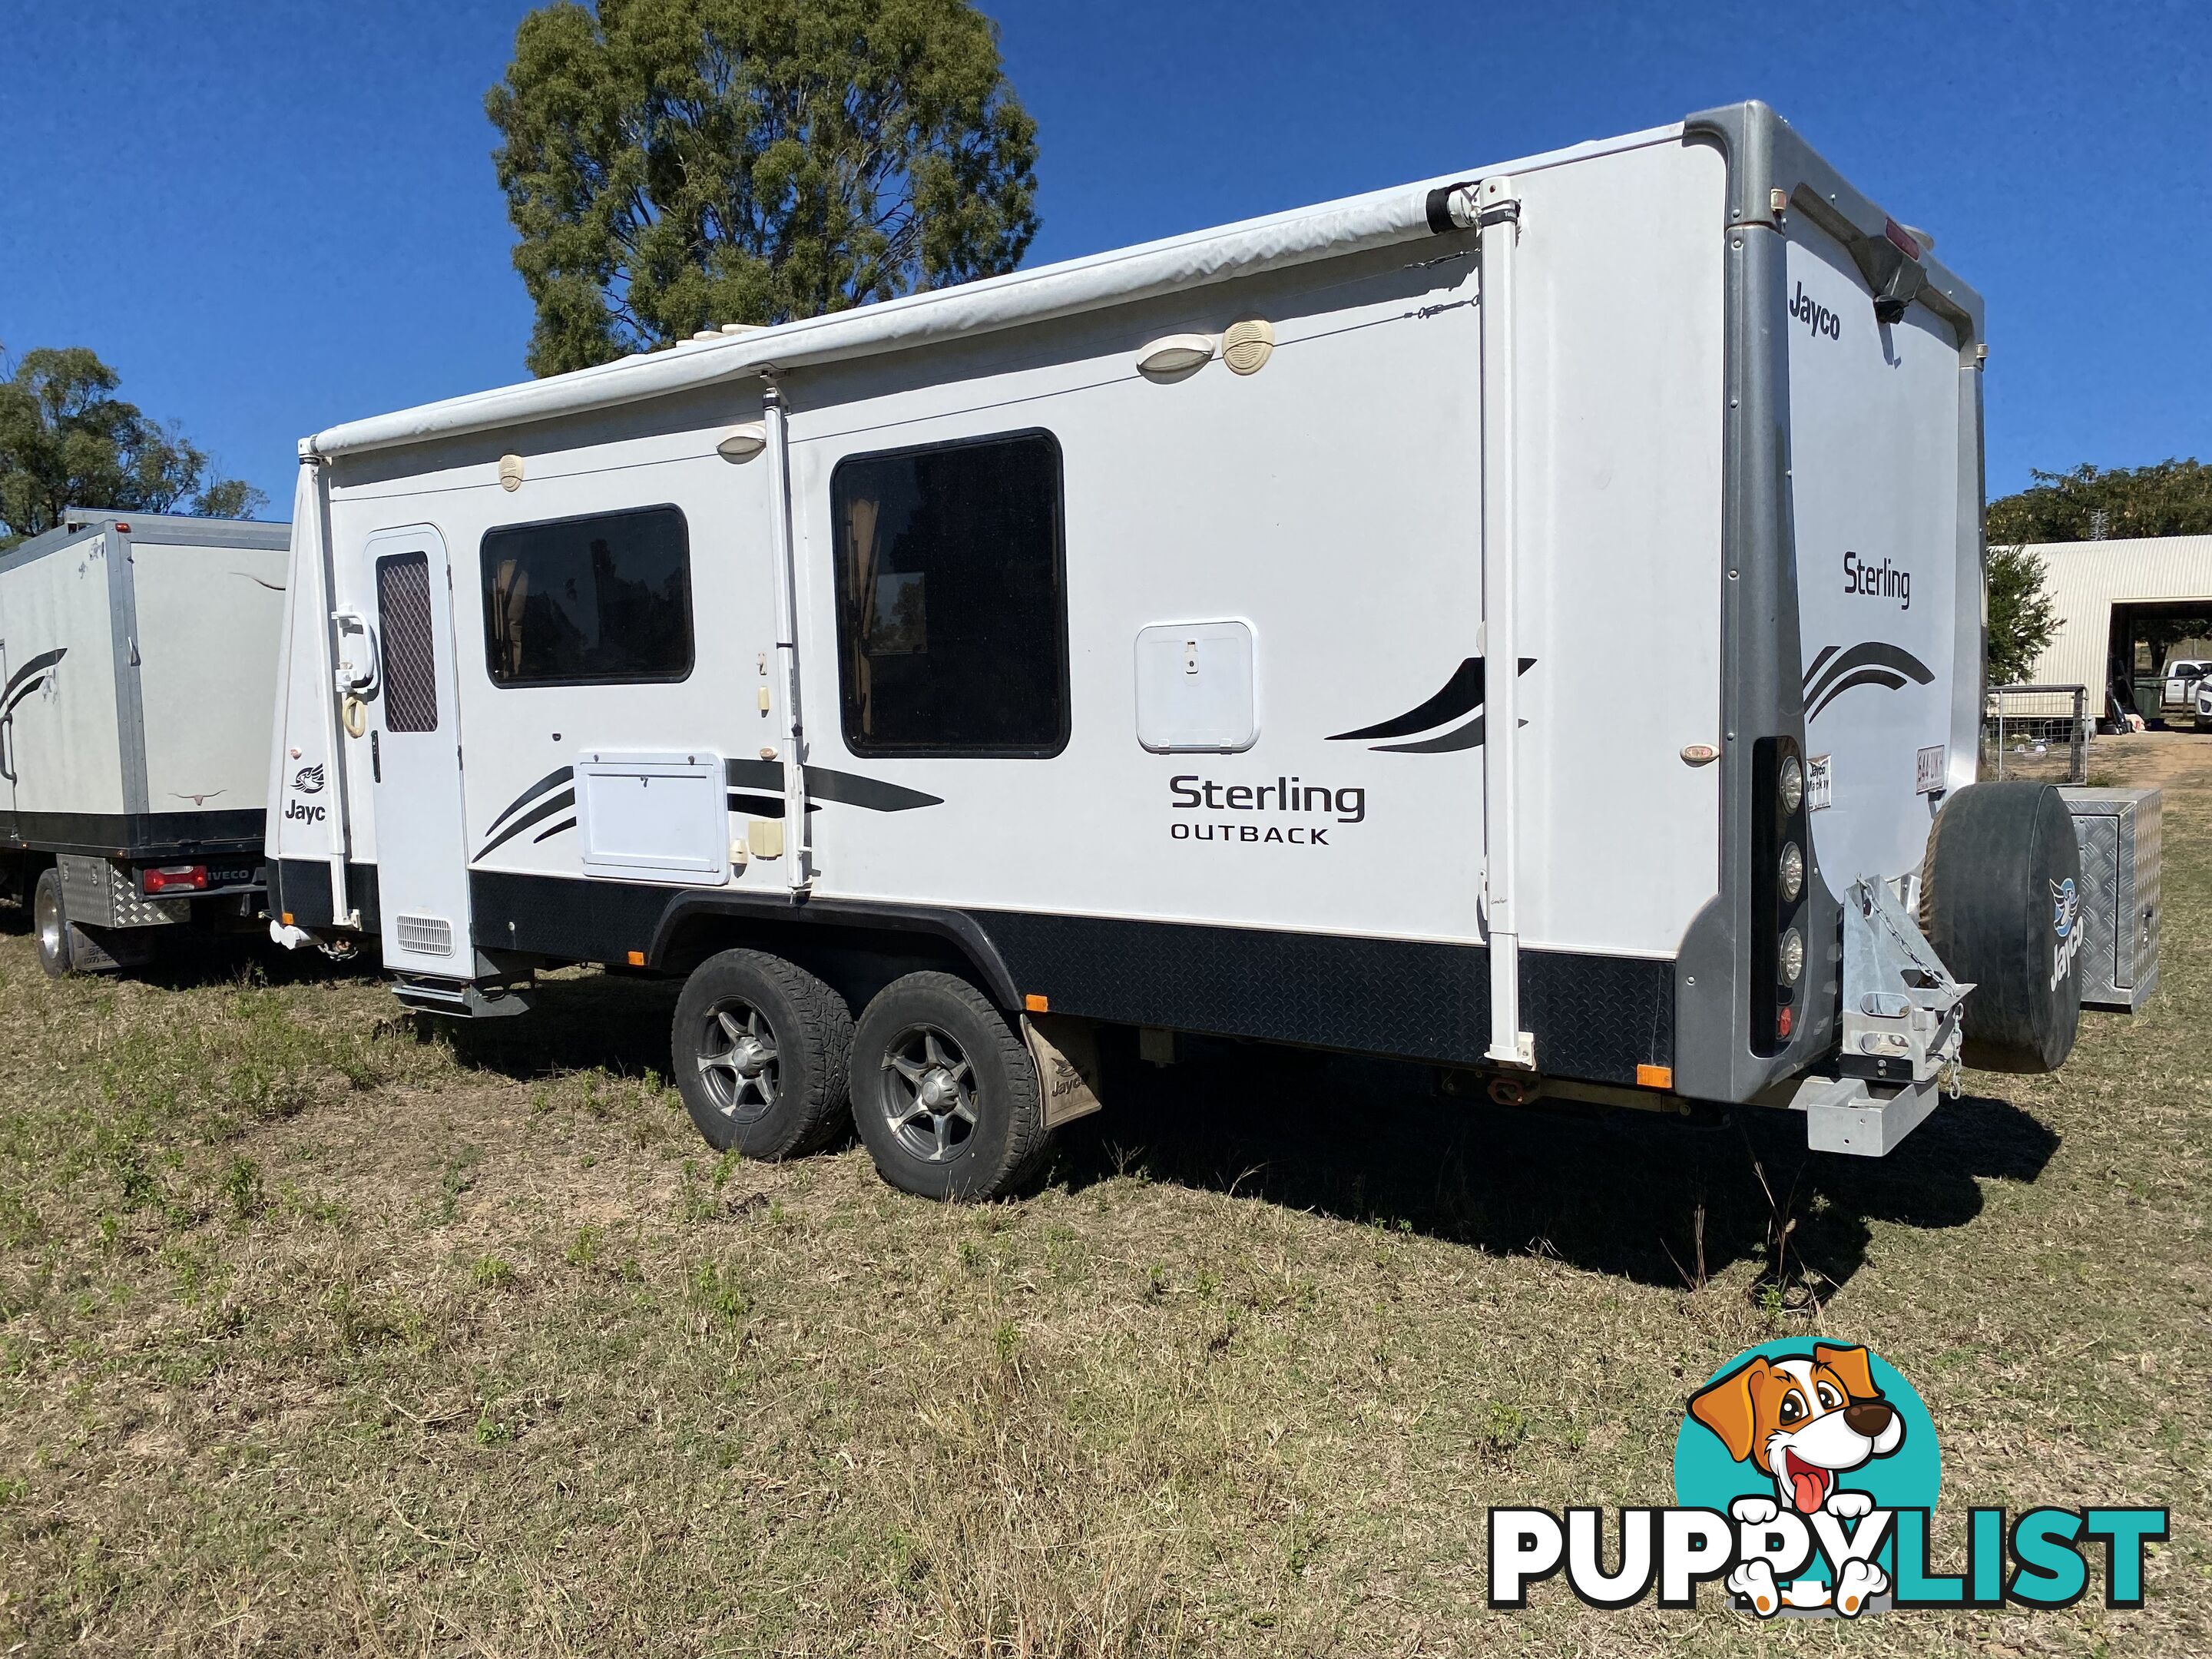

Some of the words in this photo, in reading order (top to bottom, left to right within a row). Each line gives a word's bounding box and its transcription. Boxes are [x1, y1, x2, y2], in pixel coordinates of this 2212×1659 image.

[1790, 281, 1840, 340] Jayco
[1844, 551, 1910, 611] Sterling
[1170, 775, 1365, 823] Sterling
[1171, 823, 1330, 846] OUTBACK
[207, 869, 249, 881] IVECO
[2050, 916, 2084, 992] Jayco
